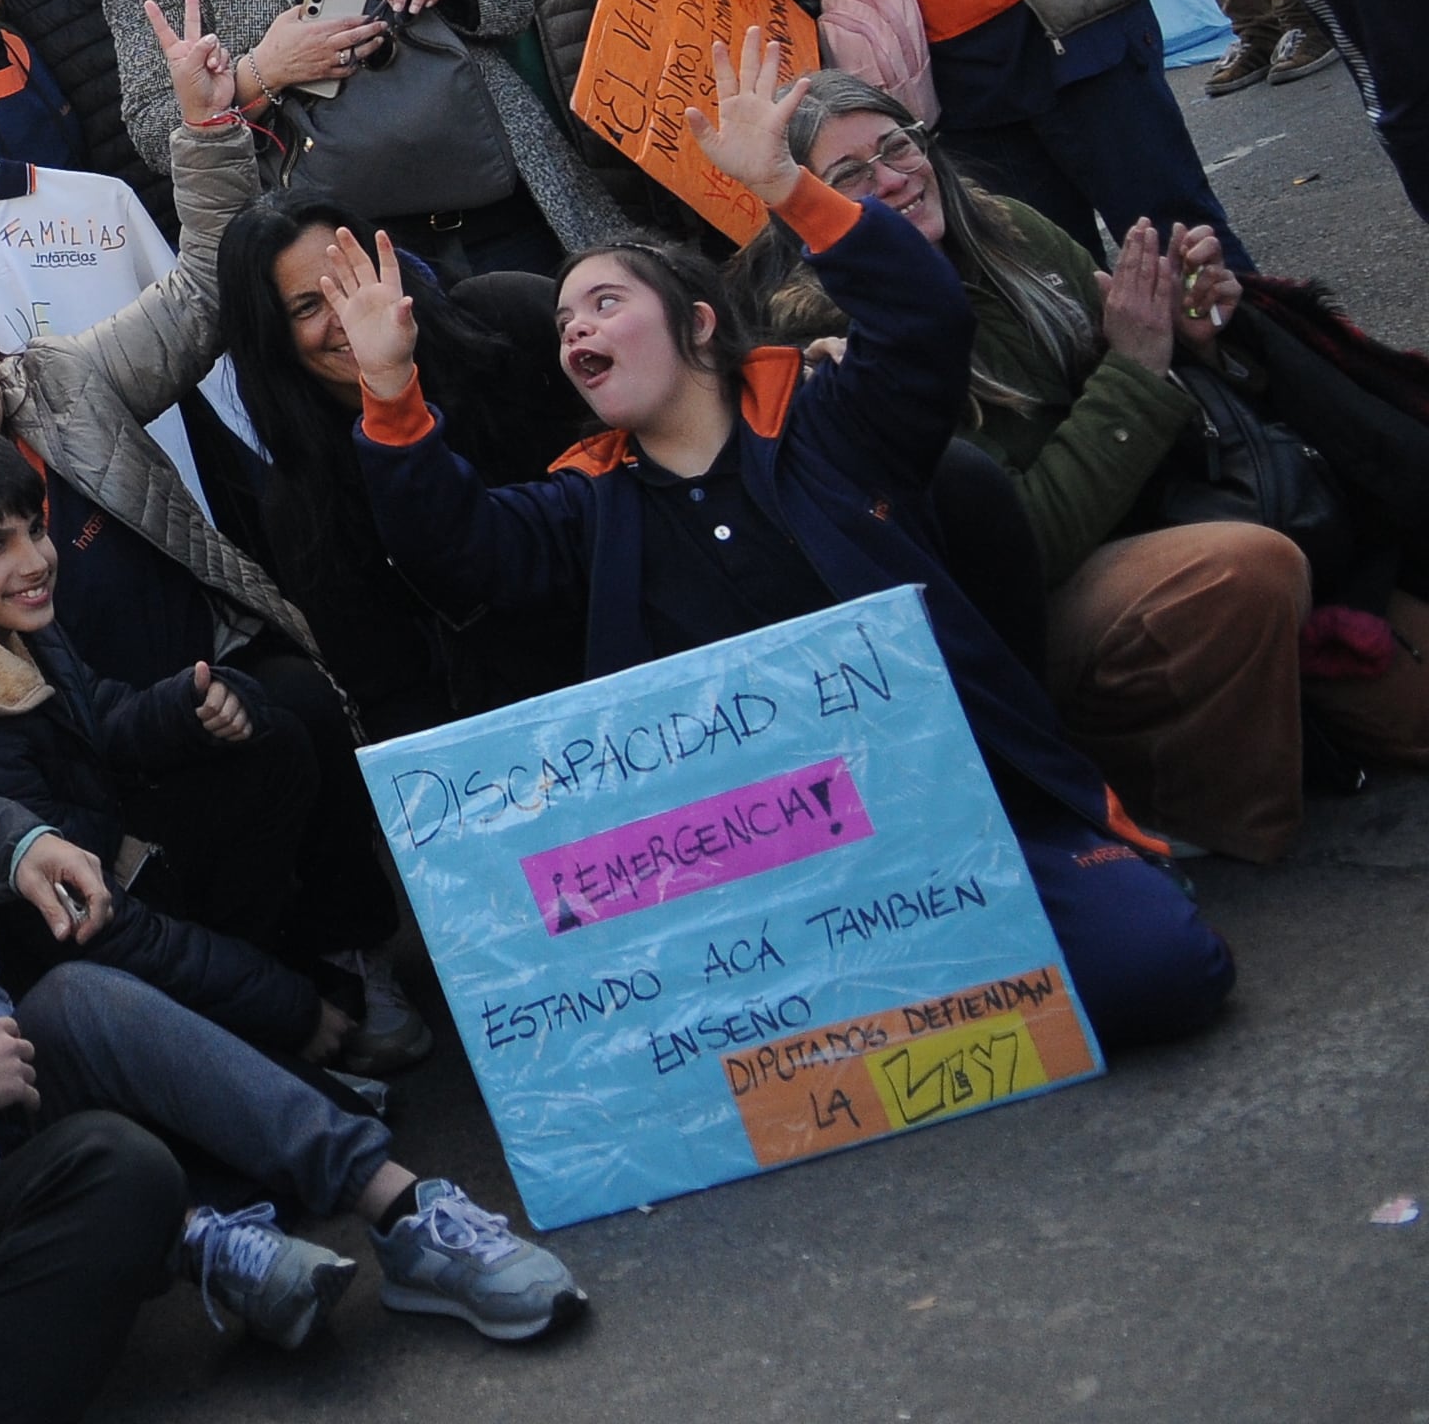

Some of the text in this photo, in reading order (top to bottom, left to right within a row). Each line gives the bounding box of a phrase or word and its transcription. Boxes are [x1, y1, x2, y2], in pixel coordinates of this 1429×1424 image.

[389, 622, 892, 852] DISCAPACIDAD EN
[551, 777, 844, 934] ¡EMERGENCIA!
[481, 868, 987, 1050] ESTANDO ACÁ TAMBIÉN
[725, 968, 1055, 1097] DIPUTADOS DEFIENDAN
[809, 1088, 861, 1131] LA
